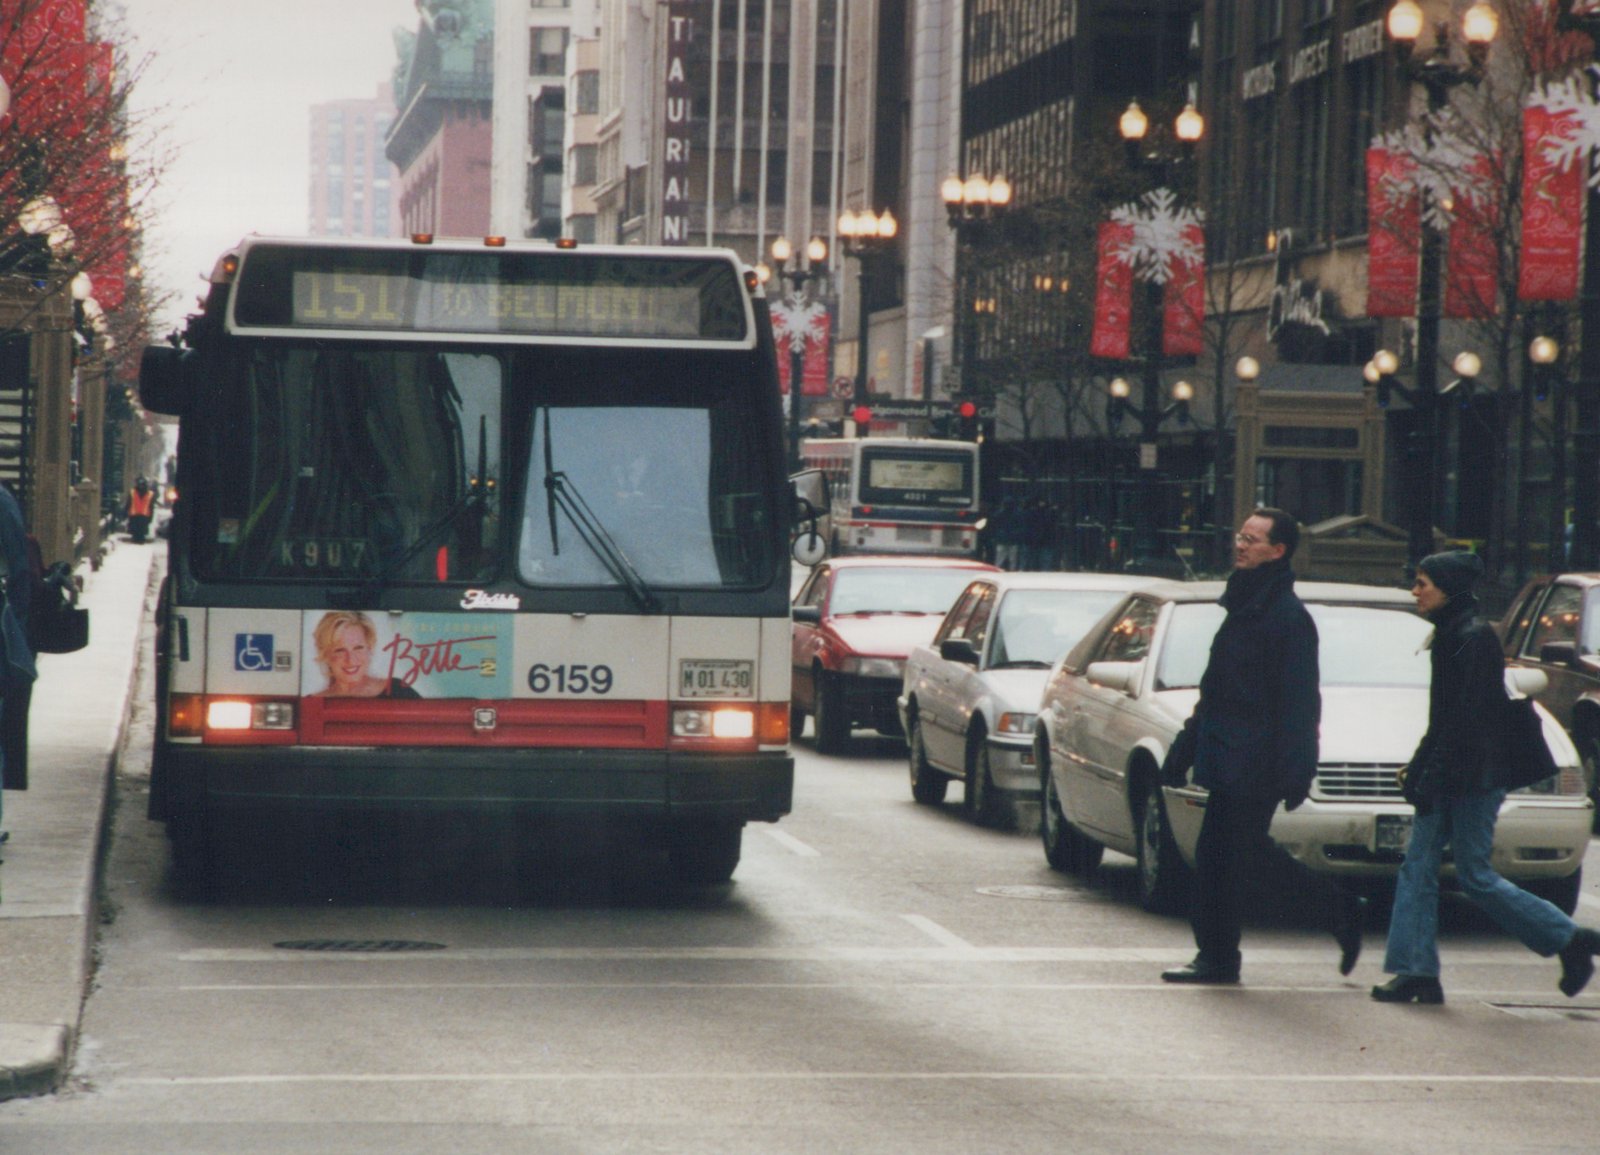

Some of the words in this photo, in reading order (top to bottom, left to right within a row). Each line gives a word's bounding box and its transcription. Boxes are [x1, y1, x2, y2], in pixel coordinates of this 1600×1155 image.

[303, 272, 396, 321] 151
[382, 633, 497, 695] Bette
[528, 663, 613, 694] 6159
